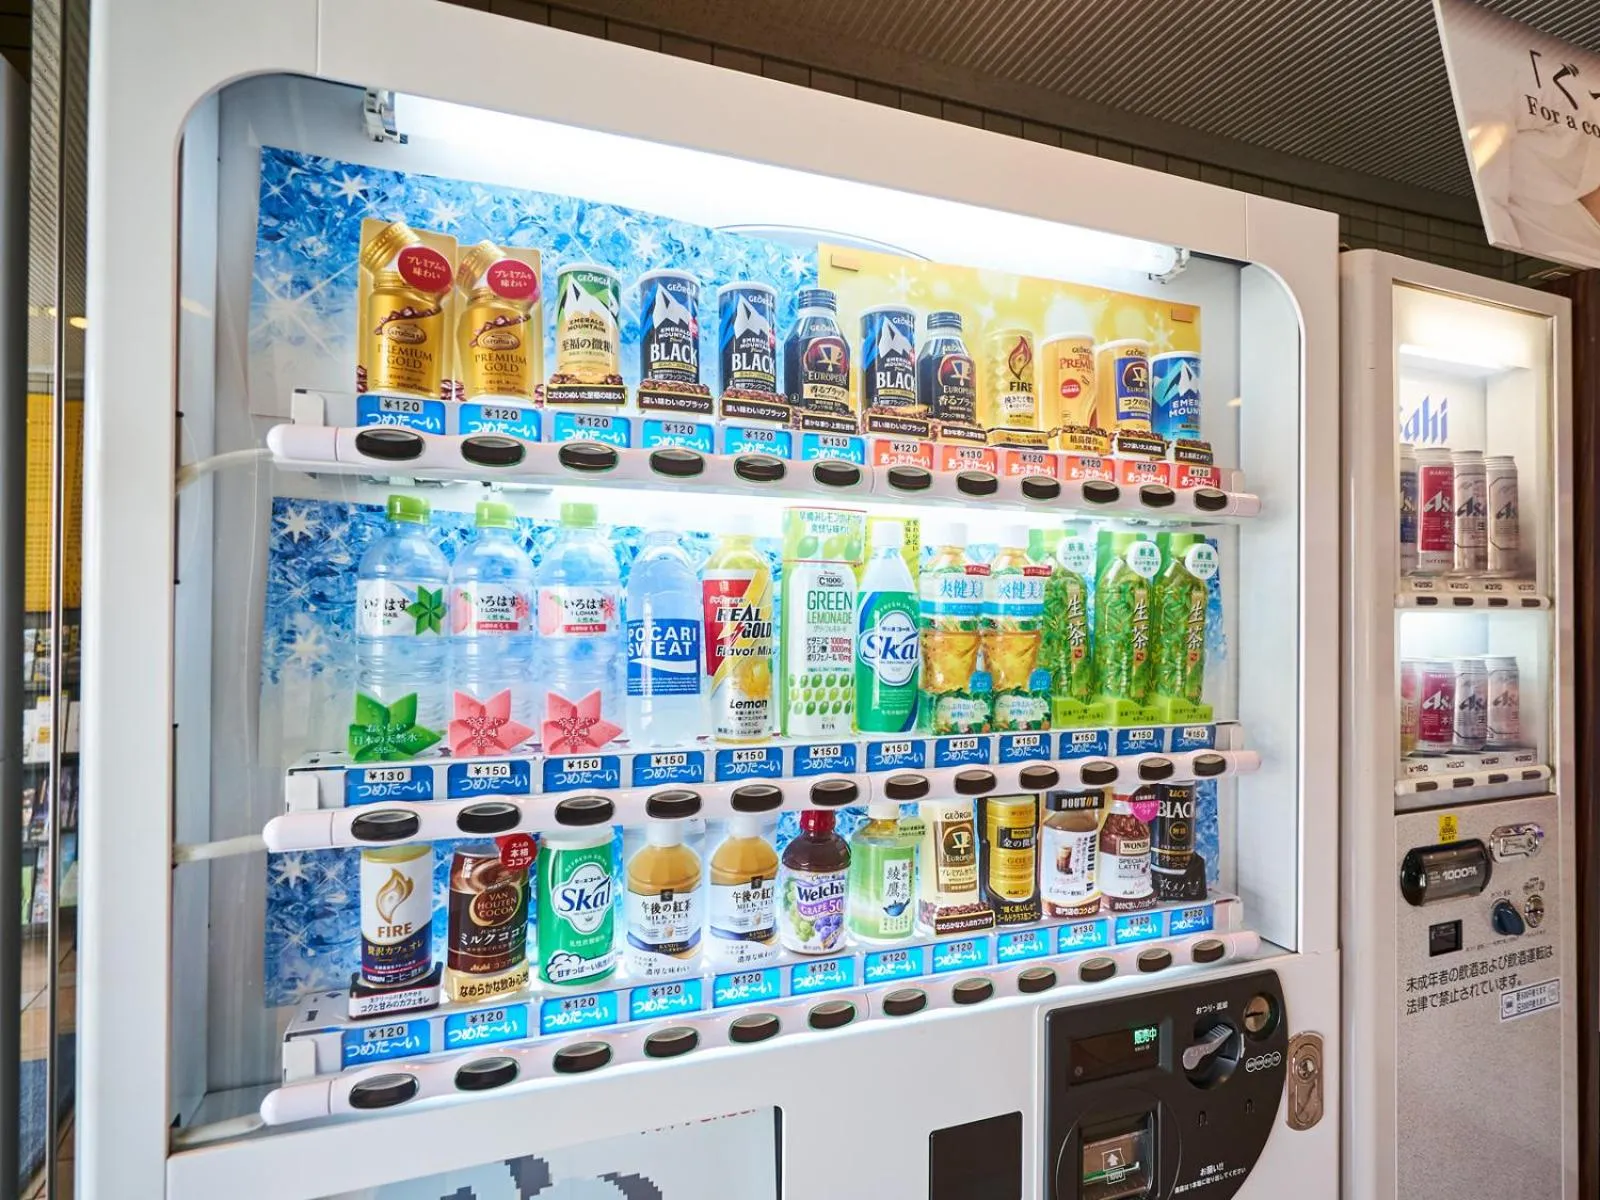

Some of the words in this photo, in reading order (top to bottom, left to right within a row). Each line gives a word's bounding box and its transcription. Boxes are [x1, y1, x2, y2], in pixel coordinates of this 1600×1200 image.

[1525, 94, 1560, 125] For
[1567, 114, 1577, 130] a
[412, 268, 440, 279] 味わい
[569, 318, 604, 326] EMERALD
[568, 324, 605, 333] MOUNTAIN
[475, 353, 526, 365] PREMIUM
[650, 343, 697, 367] BLACK
[387, 358, 422, 369] GOLD
[485, 363, 518, 373] GOLD
[732, 353, 775, 375] BLACK
[1010, 382, 1033, 392] FIRE
[384, 400, 420, 412] ¥120
[642, 396, 709, 409] 深い味わいのブラック
[484, 409, 518, 420] ¥120
[726, 405, 786, 417] 深い味わいのブラック
[578, 417, 609, 428] ¥120
[872, 421, 926, 432] 深い味わいのブラック
[664, 424, 694, 435] ¥120
[745, 431, 773, 441] ¥120
[823, 438, 848, 447] ¥130
[894, 444, 918, 453] ¥120
[960, 451, 983, 459] ¥130
[1022, 455, 1043, 463] ¥120
[1081, 459, 1101, 468] ¥120
[1136, 463, 1156, 472] ¥120
[1190, 468, 1209, 477] ¥120
[940, 579, 984, 599] 爽健美
[1000, 580, 1045, 599] 爽健美
[564, 599, 606, 610] いろはす
[807, 590, 852, 611] GREEN
[715, 603, 762, 623] REAL
[807, 612, 852, 624] LEMONADE
[1067, 596, 1086, 646] 生茶
[1131, 601, 1149, 649] 生茶
[741, 622, 772, 639] GOLD
[1187, 605, 1203, 649] 生茶
[628, 627, 697, 642] POCARI
[807, 637, 829, 646] ビタミンC
[830, 638, 852, 646] 1000mg
[628, 641, 692, 658] SWEAT
[756, 646, 772, 655] Mix
[807, 645, 827, 654] クエン酸
[807, 654, 837, 662] ポリフェノール
[730, 699, 767, 710] Lemon
[466, 717, 505, 726] やさしい
[558, 717, 596, 725] やさしい
[366, 723, 407, 732] おいしい
[471, 729, 497, 737] もも味
[564, 729, 589, 737] もも味
[354, 733, 418, 745] 日本の天然水
[1075, 733, 1096, 742] ¥150
[1132, 730, 1152, 740] ¥150
[952, 739, 975, 749] ¥150
[1016, 736, 1038, 746] ¥150
[1123, 738, 1163, 751] つめた〜い
[813, 746, 840, 757] ¥150
[884, 743, 909, 753] ¥150
[1006, 745, 1050, 758] つめた〜い
[1065, 741, 1108, 755] つめた〜い
[655, 755, 685, 765] ¥150
[736, 751, 765, 762] ¥150
[874, 752, 925, 766] つめた〜い
[942, 749, 989, 763] つめた〜い
[567, 759, 599, 769] ¥150
[725, 761, 781, 775] つめた〜い
[802, 756, 855, 770] つめた〜い
[368, 770, 405, 782] ¥130
[474, 766, 508, 776] ¥150
[642, 765, 703, 780] つめた〜い
[554, 769, 619, 785] つめた〜い
[357, 780, 431, 797] つめた〜い
[459, 775, 528, 791] つめた〜い
[1062, 796, 1098, 808] DOUTOR
[510, 849, 529, 857] 本格
[507, 856, 532, 867] ココア
[886, 866, 901, 898] 綾鷹
[489, 892, 508, 900] VAN
[797, 882, 844, 902] Welch's
[477, 897, 517, 910] HOUTEN
[641, 899, 691, 915] 午後の紅茶
[801, 903, 828, 914] GRAPE
[479, 907, 514, 918] COCOA
[1184, 909, 1203, 918] ¥120
[1130, 917, 1149, 925] ¥120
[377, 922, 412, 937] FIRE
[460, 920, 528, 945] ミルクココア
[1073, 925, 1094, 933] ¥130
[1013, 933, 1035, 942] ¥120
[950, 943, 973, 952] ¥120
[882, 953, 907, 962] ¥120
[810, 962, 836, 972] ¥120
[1406, 945, 1554, 993] 未成年者の飲酒および飲酒運転は
[733, 974, 761, 984] ¥120
[794, 971, 848, 989] つめた〜い
[460, 974, 528, 997] なめらかな飲み心地
[652, 985, 681, 996] ¥120
[716, 983, 773, 1000] つめた〜い
[1406, 974, 1522, 1016] 法律で禁止されています。
[361, 997, 430, 1012] コクと甘みのカフェオレ
[564, 998, 595, 1009] ¥120
[632, 995, 694, 1014] つめた〜い
[470, 1011, 503, 1023] ¥120
[544, 1008, 609, 1027] つめた〜い
[369, 1026, 404, 1039] ¥120
[448, 1023, 518, 1043] つめた〜い
[1135, 1027, 1157, 1044] 販売中
[345, 1035, 420, 1057] つめた〜い
